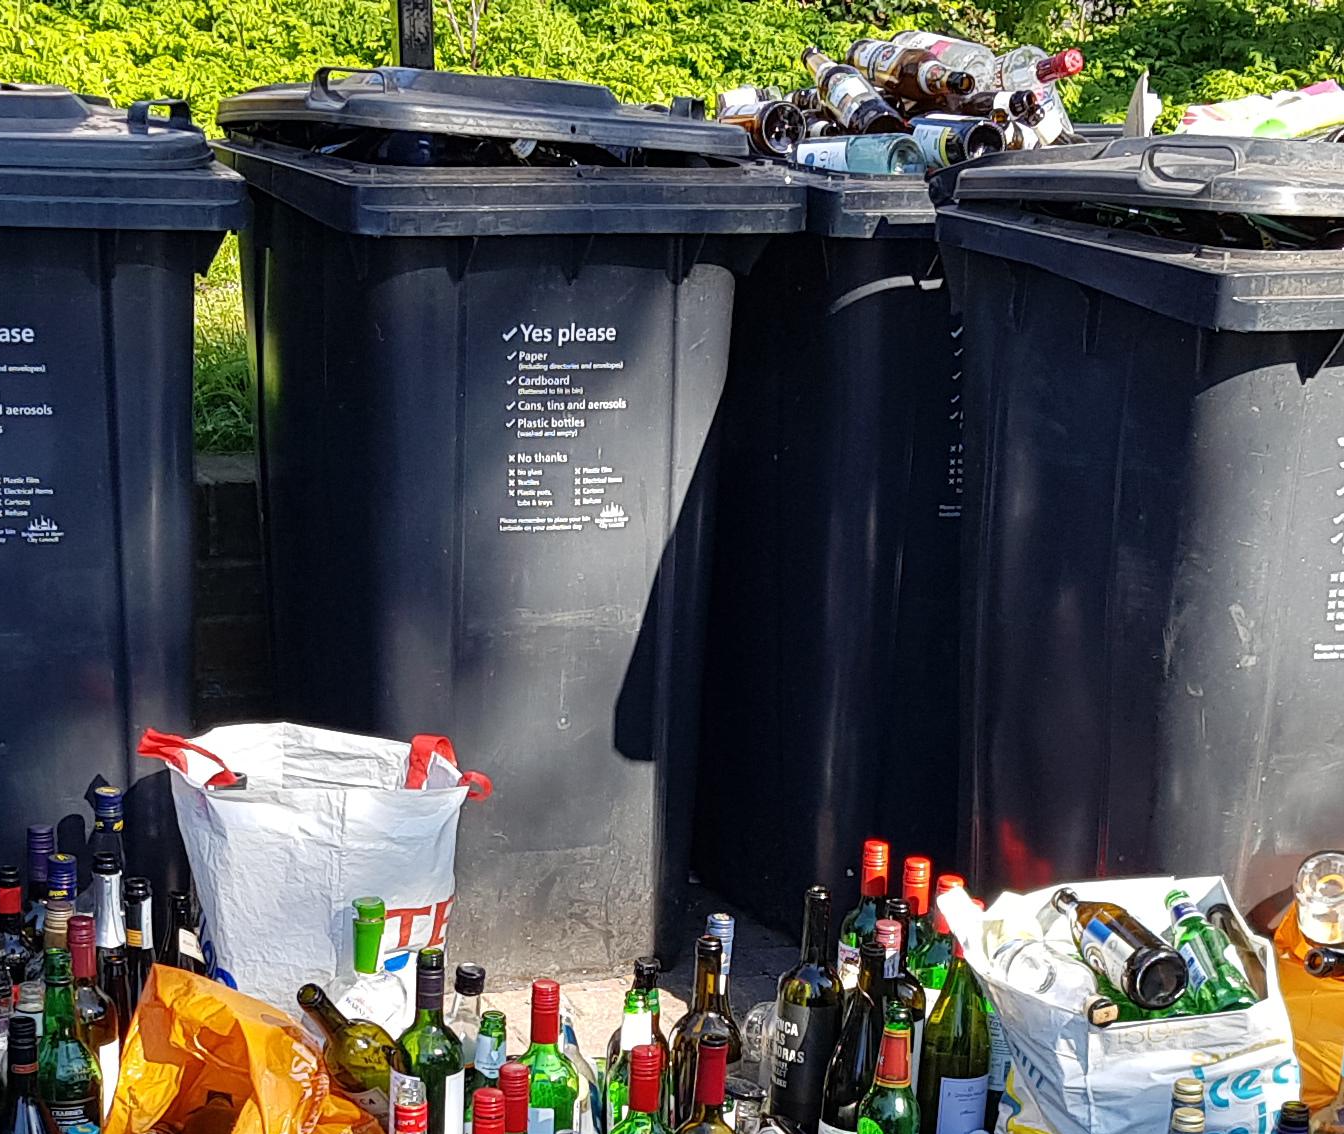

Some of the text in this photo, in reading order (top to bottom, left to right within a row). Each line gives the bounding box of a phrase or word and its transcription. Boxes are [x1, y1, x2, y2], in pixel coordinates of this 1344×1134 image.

[520, 322, 616, 346] Yes please
[519, 351, 548, 364] Paper
[518, 375, 570, 386] Cardboard
[6, 404, 53, 415] aerosols
[518, 398, 626, 412] Cans, tins and aerosols
[518, 417, 585, 429] Plastic bottles
[518, 452, 568, 464] No thanks
